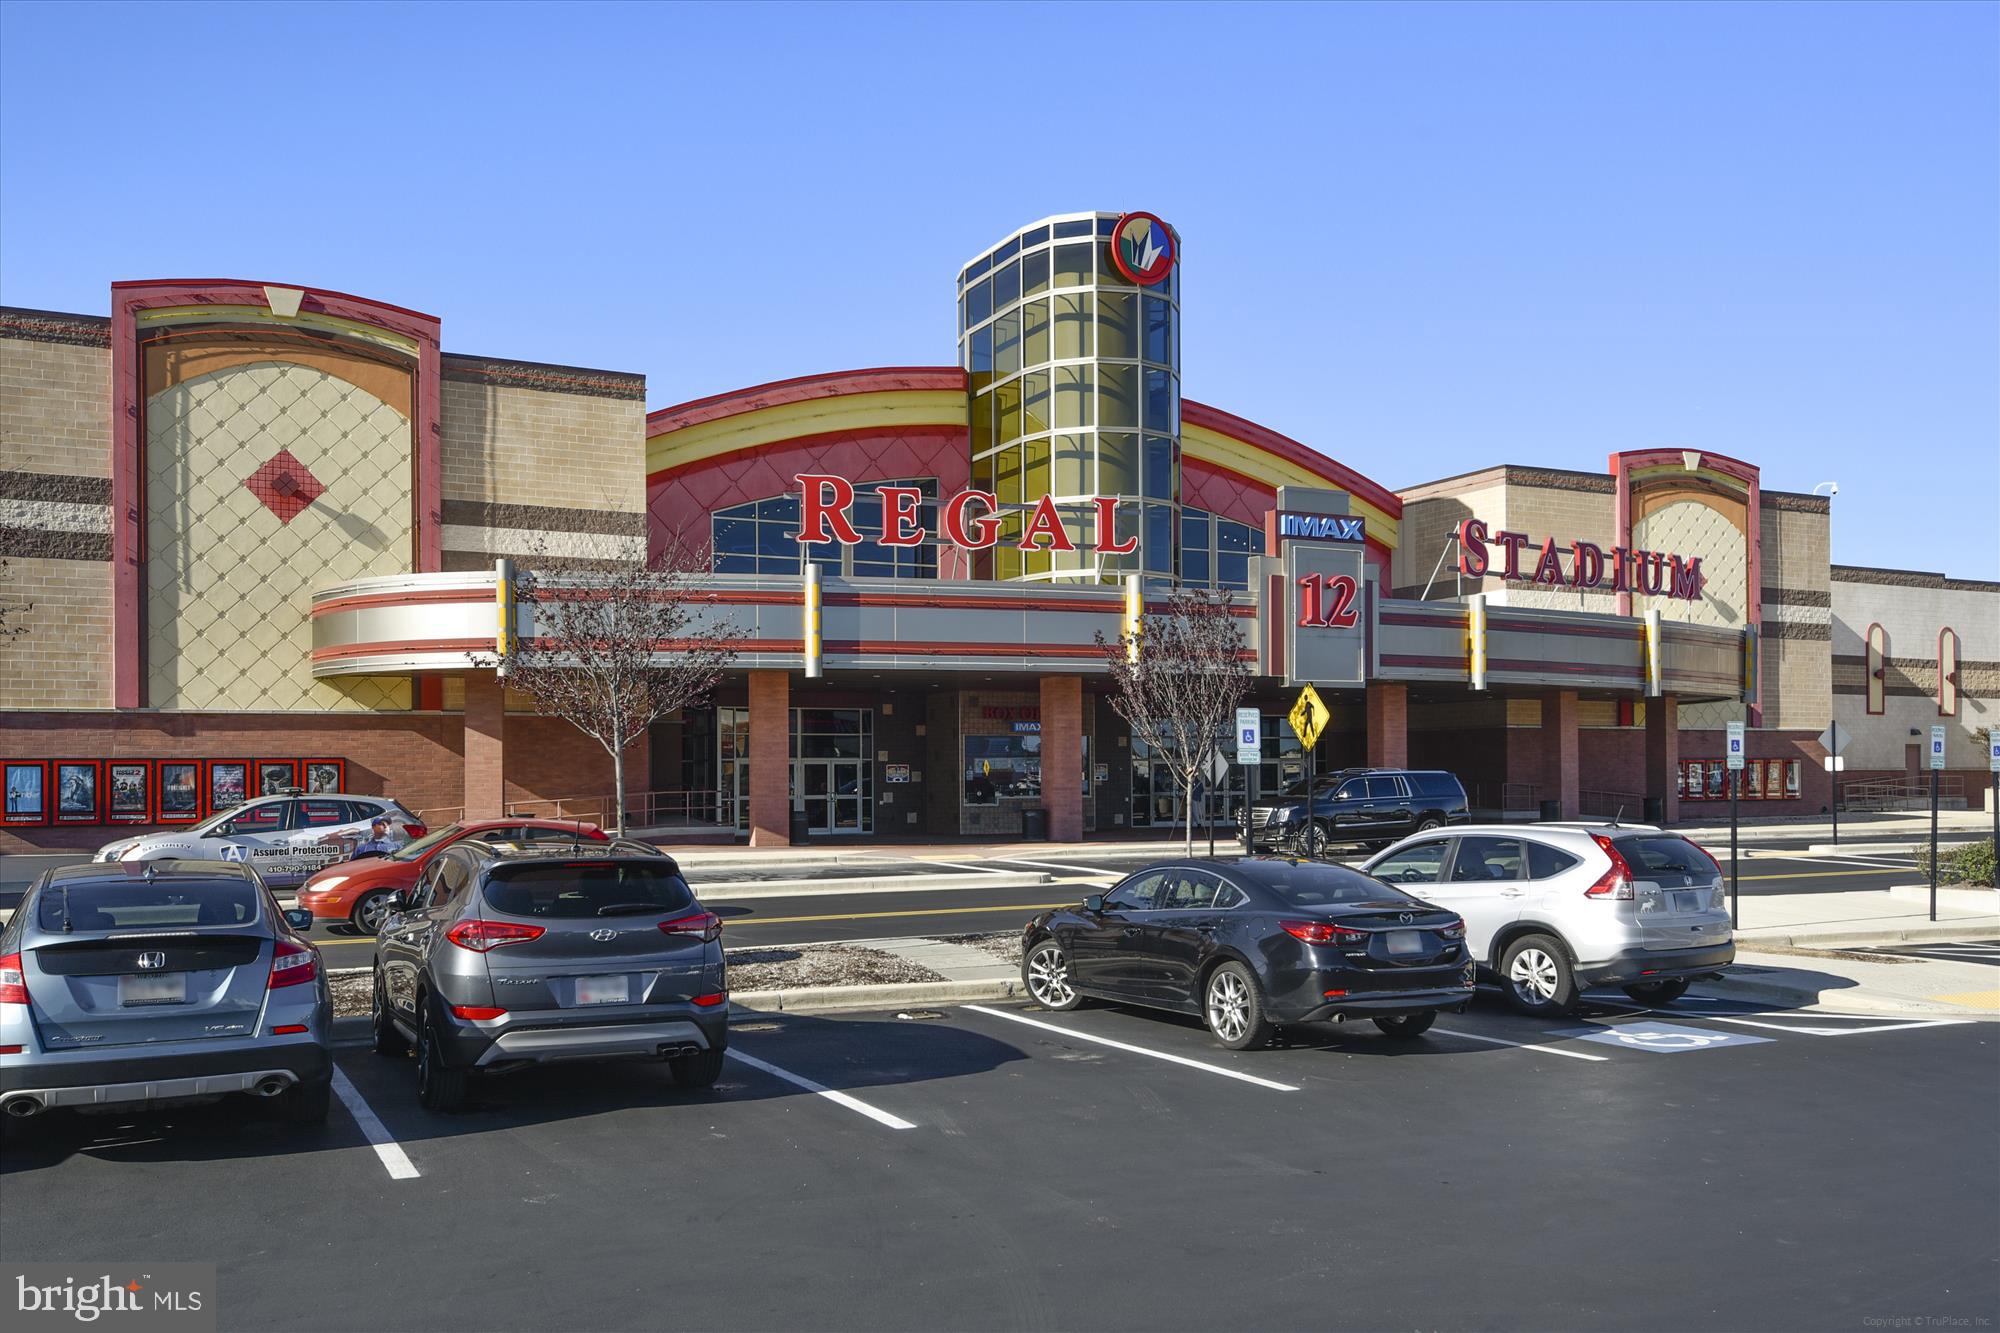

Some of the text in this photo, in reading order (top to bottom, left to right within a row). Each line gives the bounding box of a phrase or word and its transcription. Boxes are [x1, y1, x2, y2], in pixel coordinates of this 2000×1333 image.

[794, 473, 1138, 554] REGAL
[1280, 514, 1364, 540] IMAX
[1459, 518, 1703, 600] STADIUM
[1299, 573, 1359, 629] 12
[142, 843, 192, 852] SECURITY
[253, 845, 339, 857] Assured Protection
[267, 864, 322, 873] 410-790-9184
